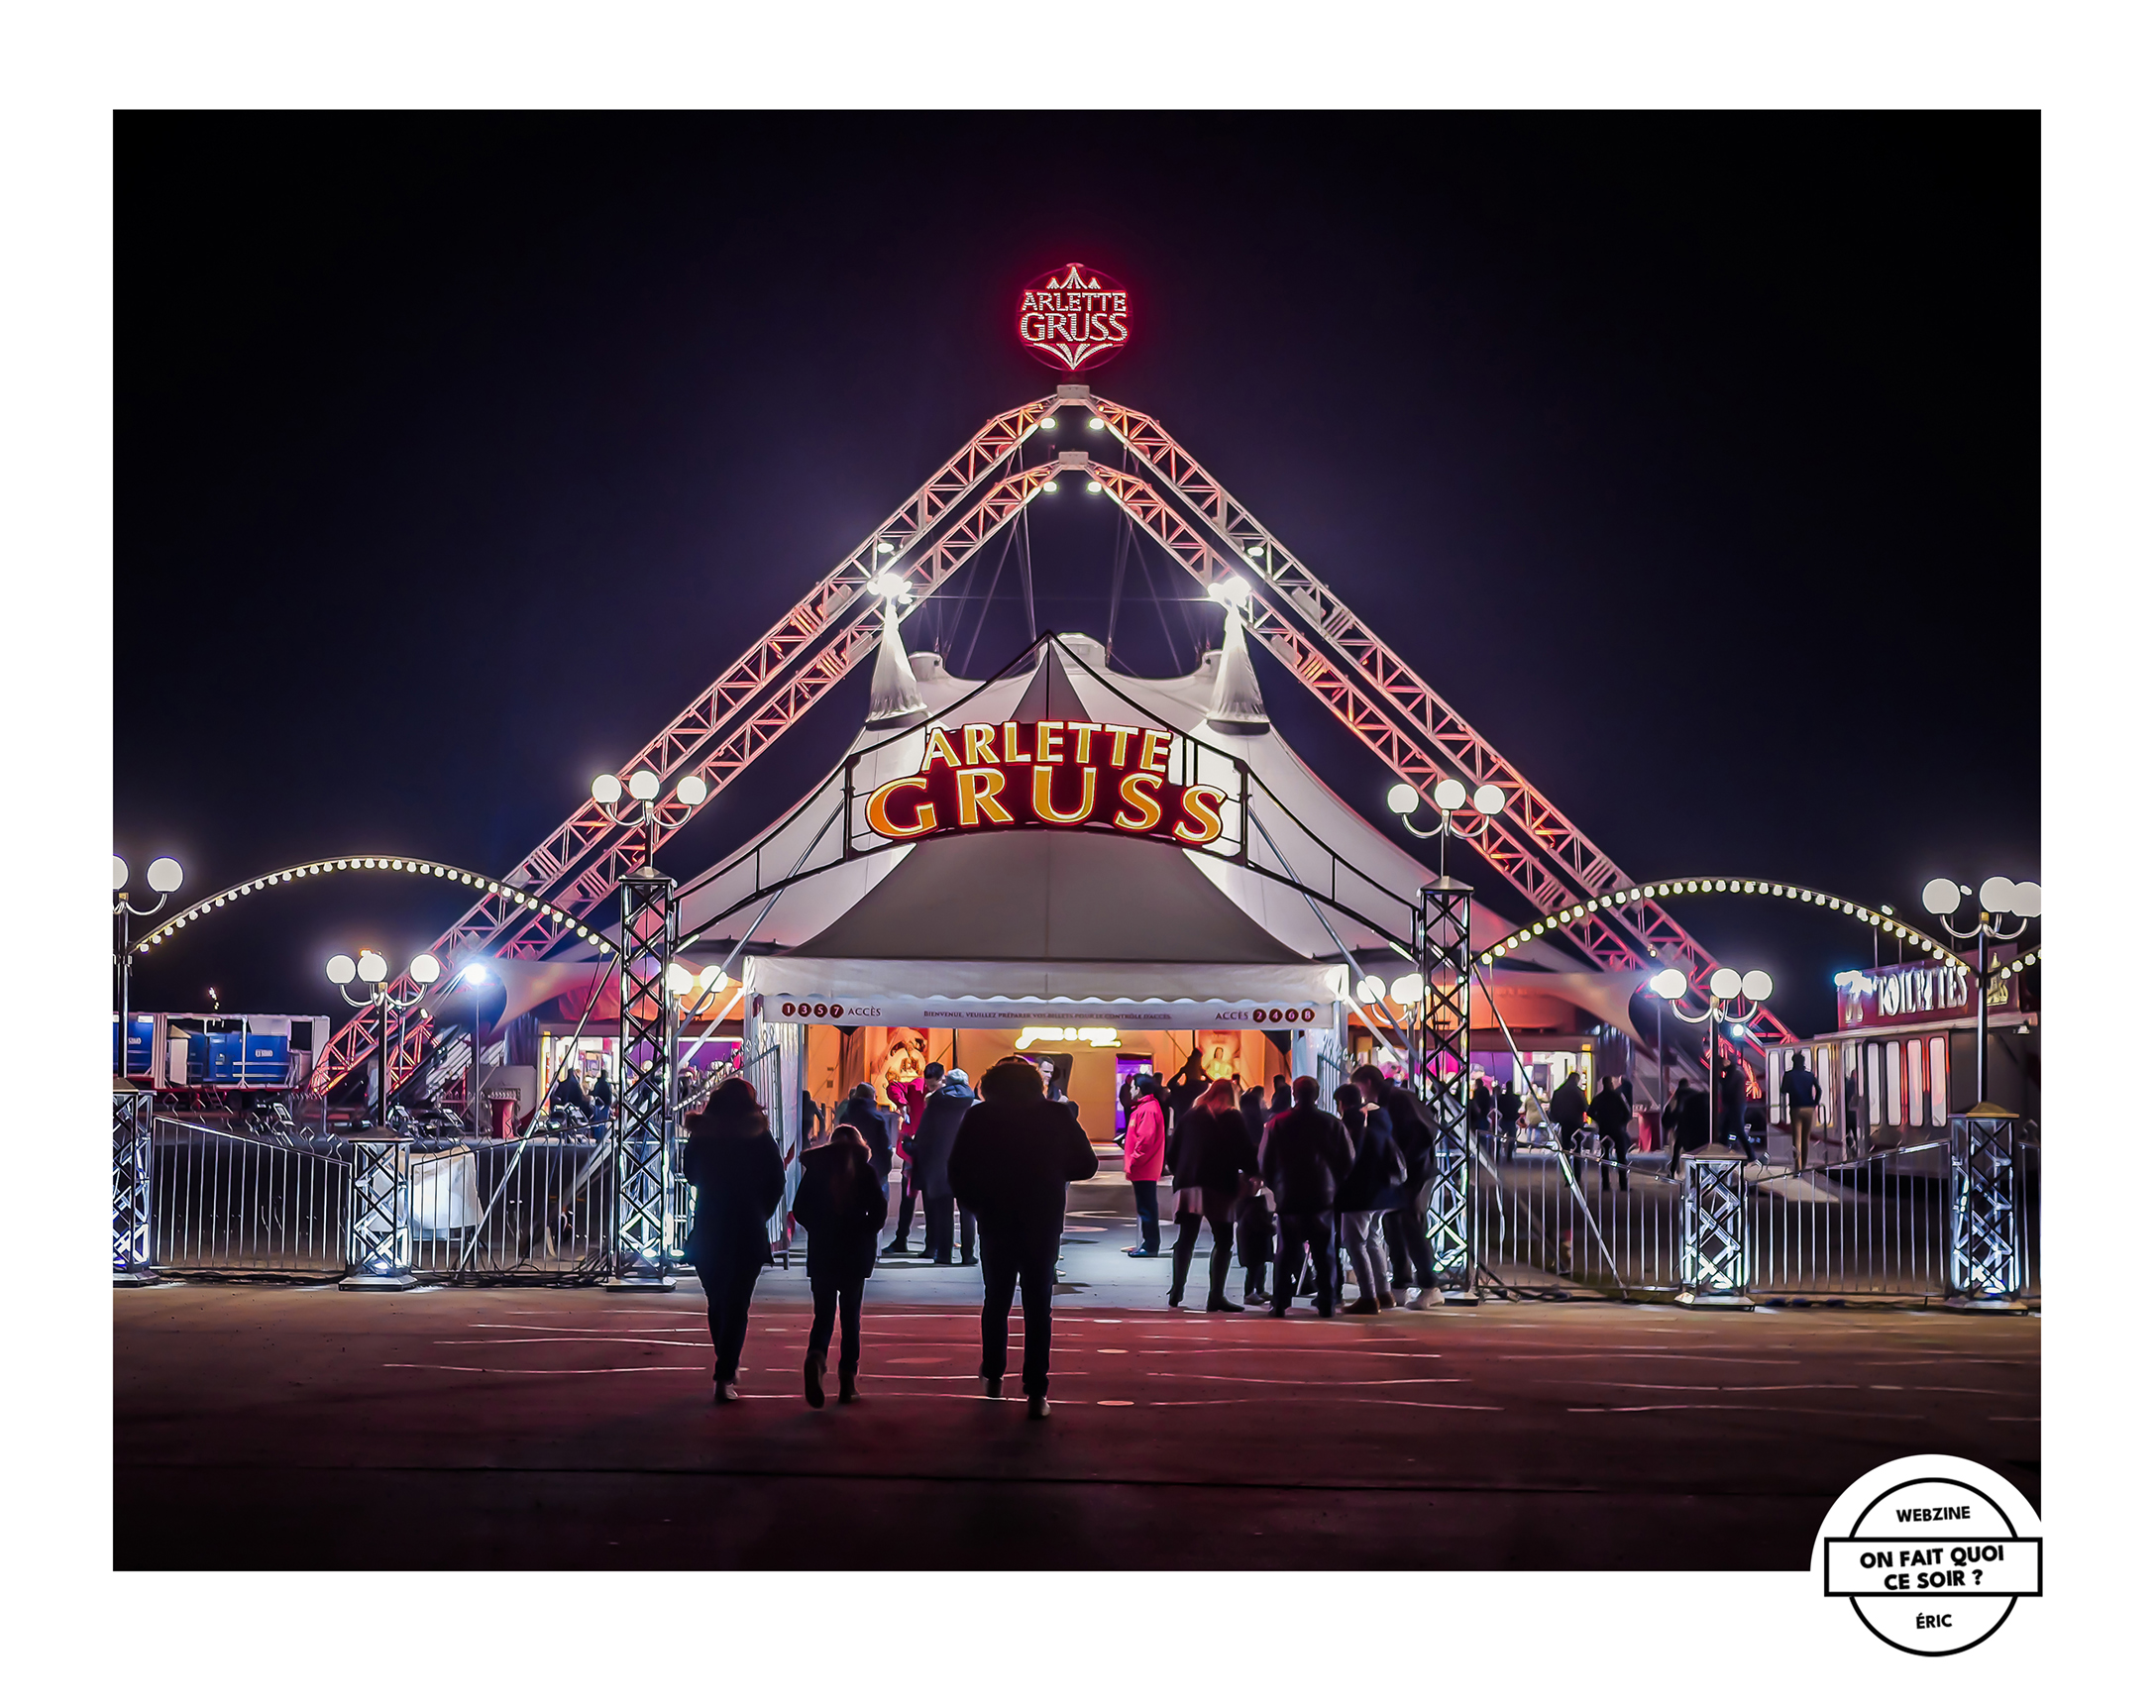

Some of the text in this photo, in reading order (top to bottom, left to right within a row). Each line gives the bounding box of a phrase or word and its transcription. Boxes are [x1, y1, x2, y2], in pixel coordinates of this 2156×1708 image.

[1022, 291, 1127, 312] ARLETTE
[1021, 312, 1128, 342] GRUSS
[921, 721, 1173, 773] ARLETTE
[867, 766, 1228, 844] GRUSS
[847, 1006, 881, 1016] ACCÈS
